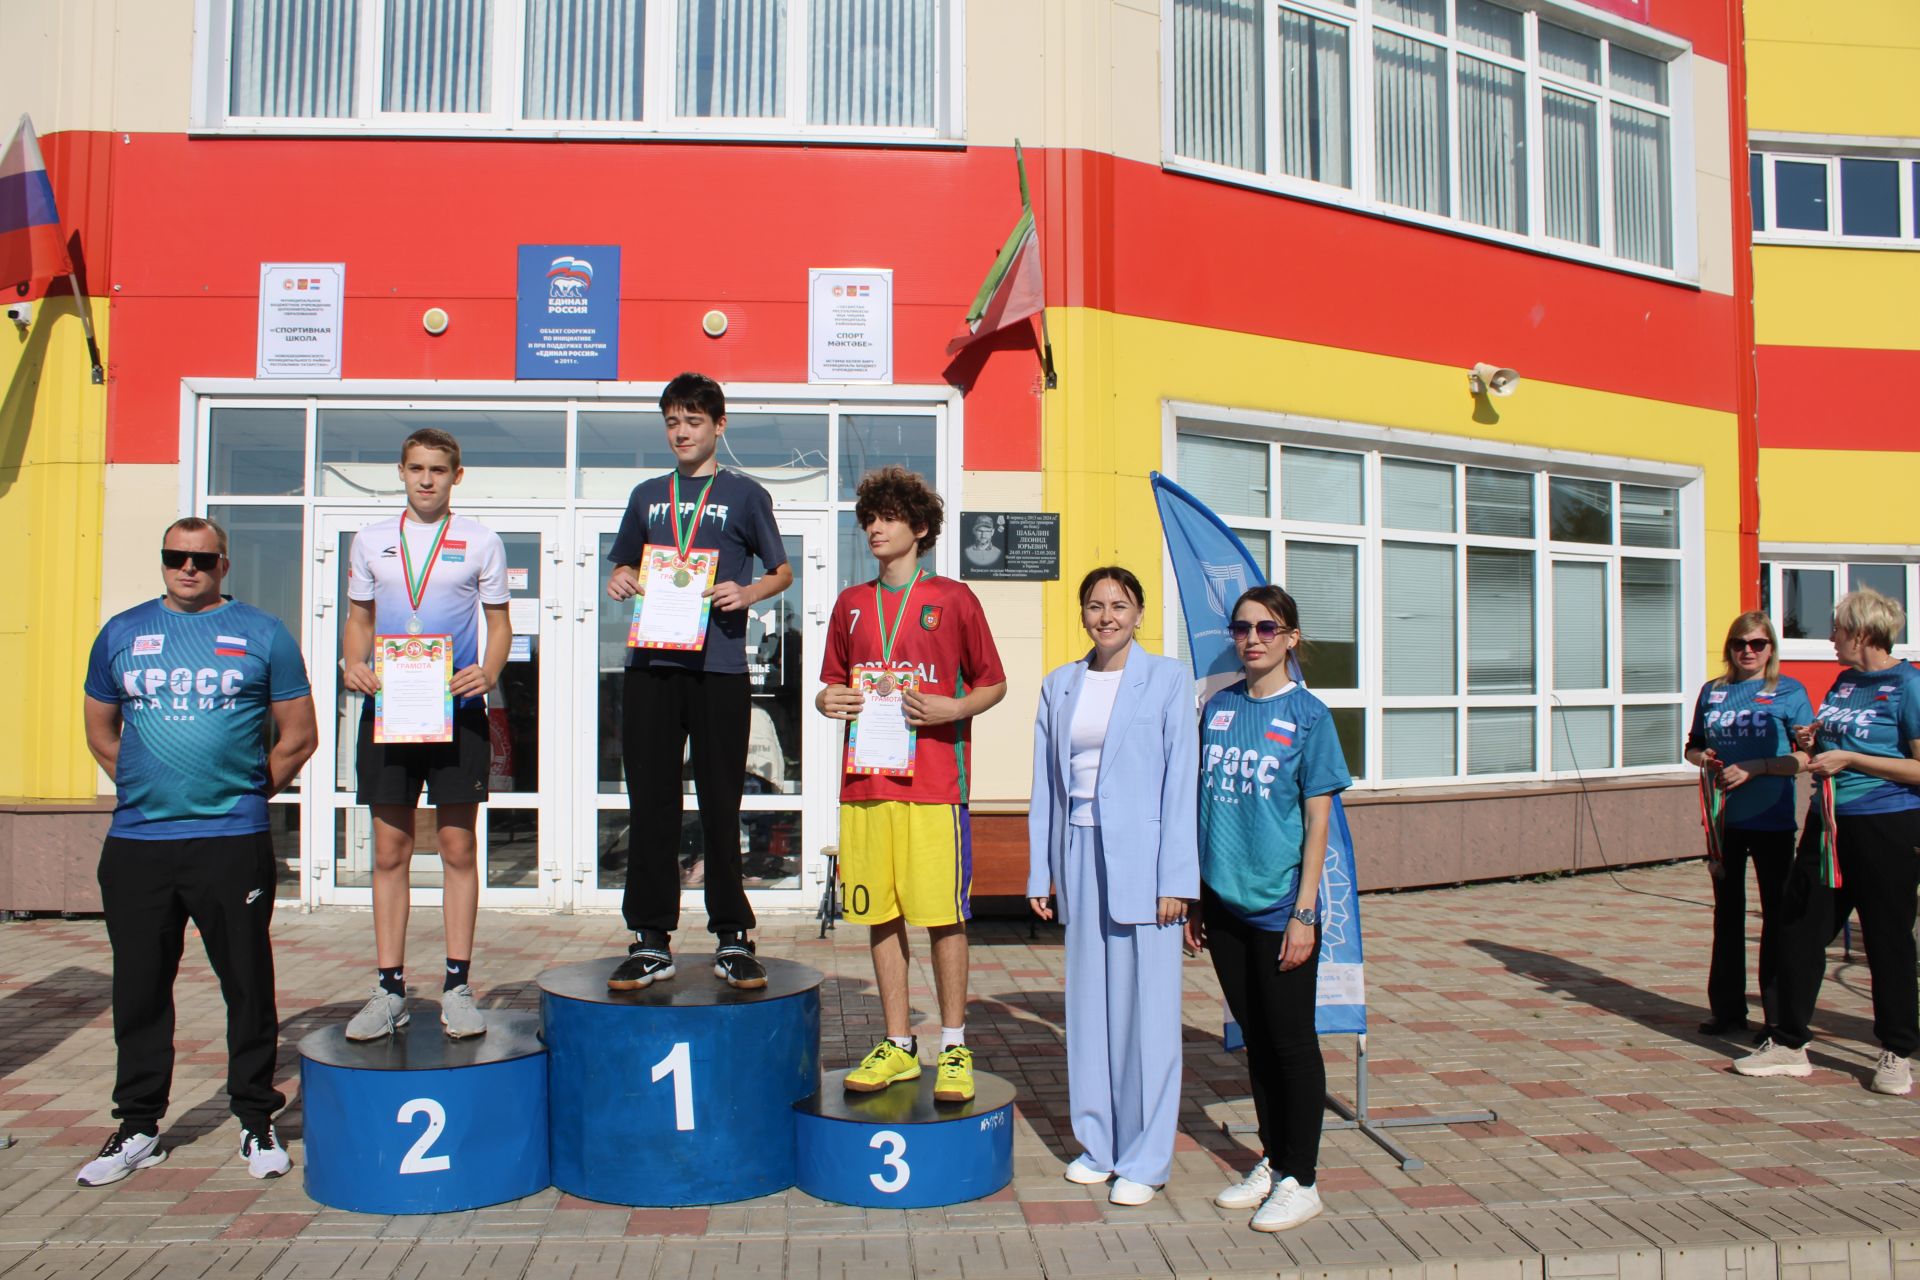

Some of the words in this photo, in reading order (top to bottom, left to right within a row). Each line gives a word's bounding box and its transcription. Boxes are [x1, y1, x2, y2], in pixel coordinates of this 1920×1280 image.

[548, 298, 588, 306] ЕДИНАЯ
[548, 306, 588, 314] РОССИЯ
[850, 608, 860, 634] 7
[396, 662, 432, 670] ГРАМОТА
[124, 668, 244, 696] КРОСС
[134, 698, 236, 710] НАЦИИ
[1704, 710, 1767, 728] РОСС
[1708, 728, 1767, 738] АЦИИ
[1824, 720, 1870, 738] ЦИИ
[840, 882, 870, 916] 10
[652, 1042, 695, 1131] 1
[396, 1098, 450, 1174] 2
[870, 1130, 910, 1193] 3
